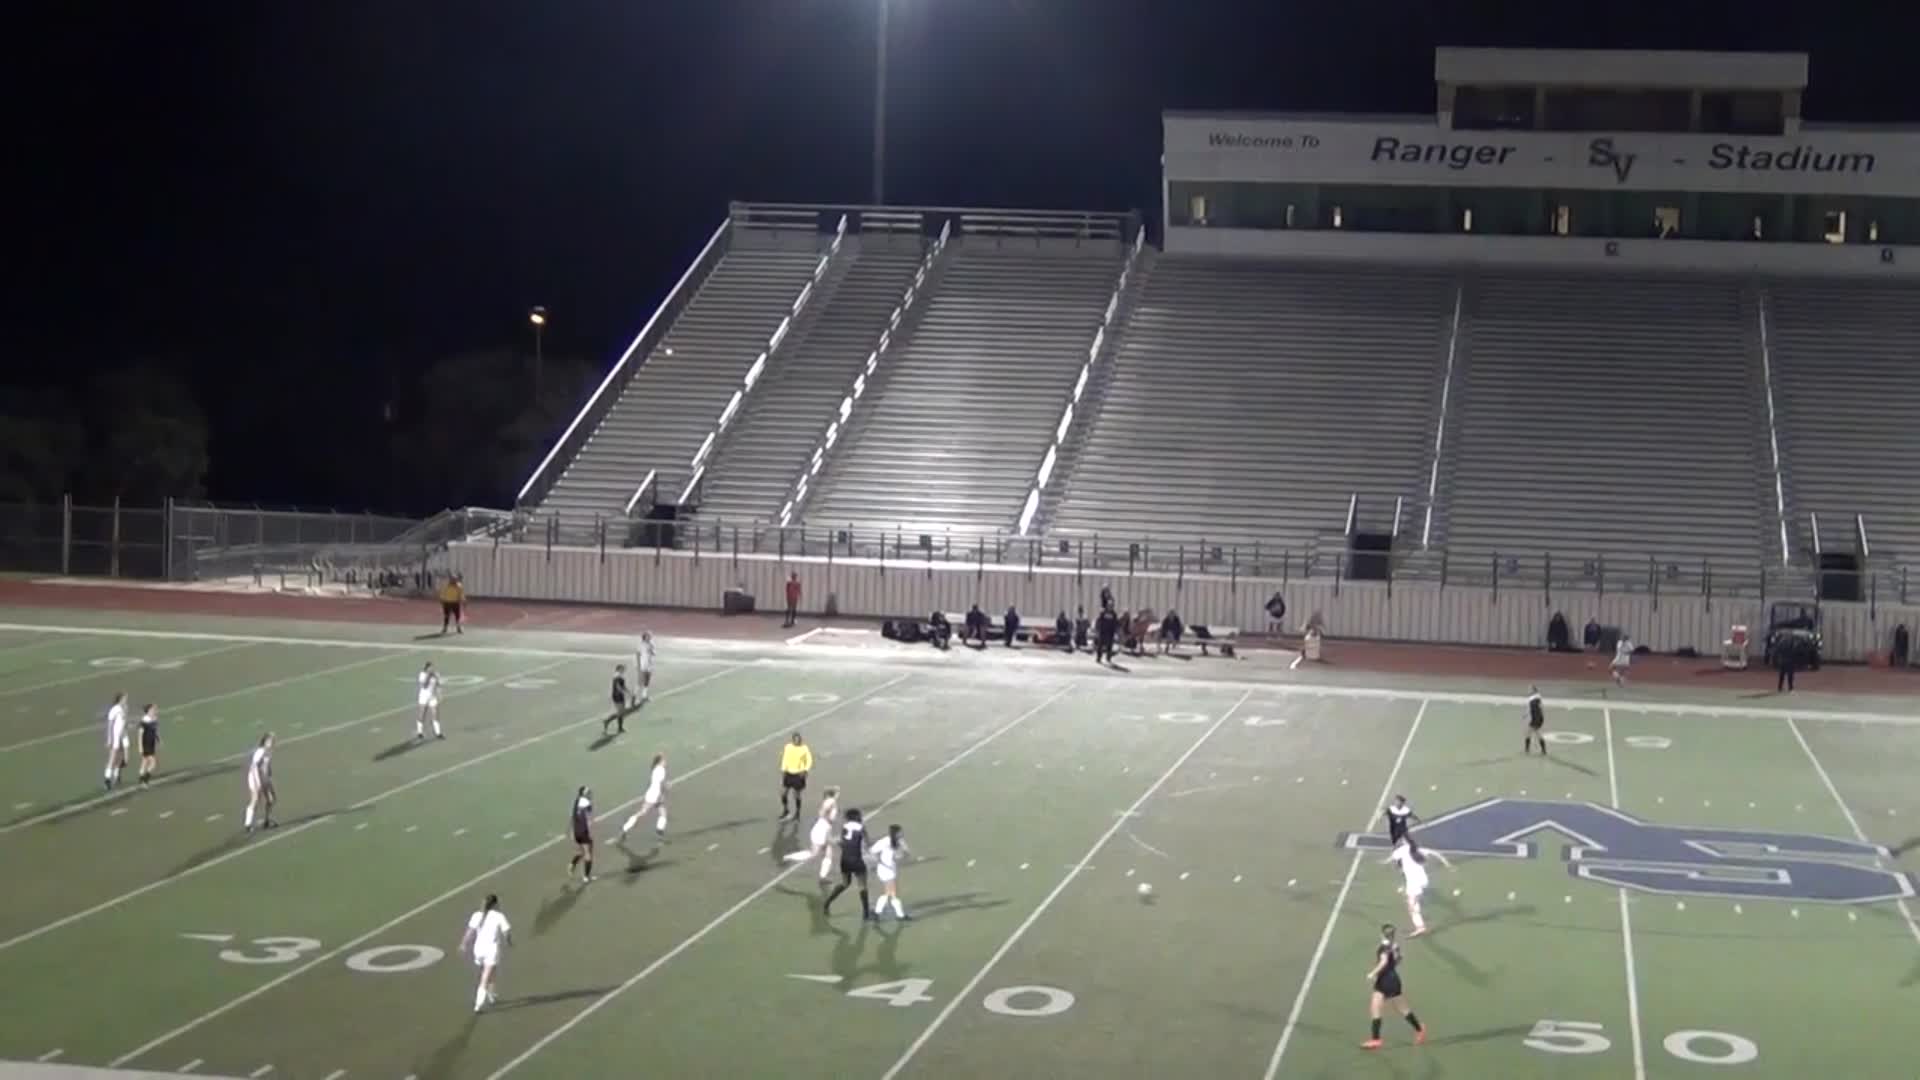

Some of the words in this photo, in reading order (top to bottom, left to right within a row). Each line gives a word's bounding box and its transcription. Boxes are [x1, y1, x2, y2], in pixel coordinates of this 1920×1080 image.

[1208, 133, 1293, 148] Welcome
[1300, 134, 1320, 148] To
[1370, 136, 1517, 170] Ranger
[1588, 138, 1637, 184] SV
[1707, 143, 1876, 173] Stadium
[1523, 1019, 1758, 1064] 50
